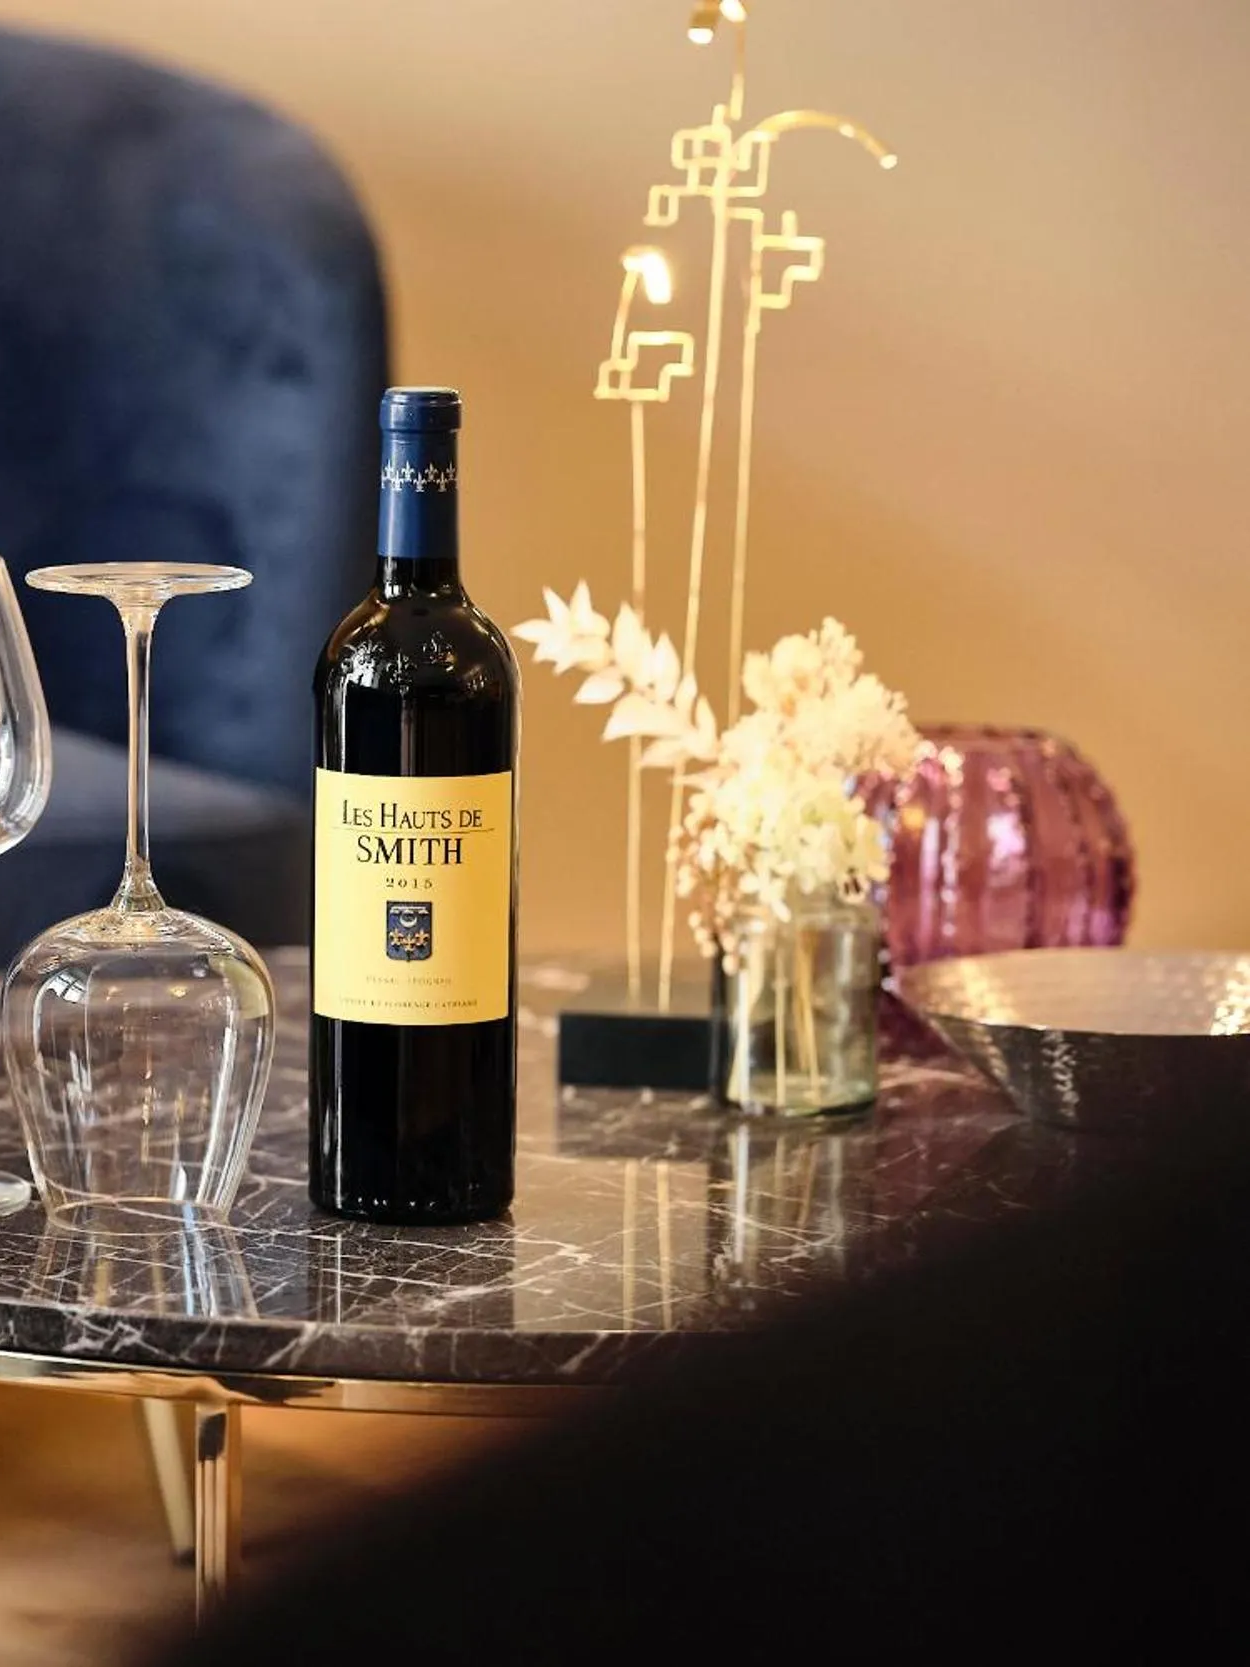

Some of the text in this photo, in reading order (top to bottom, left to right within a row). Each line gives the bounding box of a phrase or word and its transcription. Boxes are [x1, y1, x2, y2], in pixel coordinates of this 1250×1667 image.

[342, 799, 483, 830] LES HAUTS DE
[356, 835, 464, 865] SMITH
[385, 877, 433, 889] 2015
